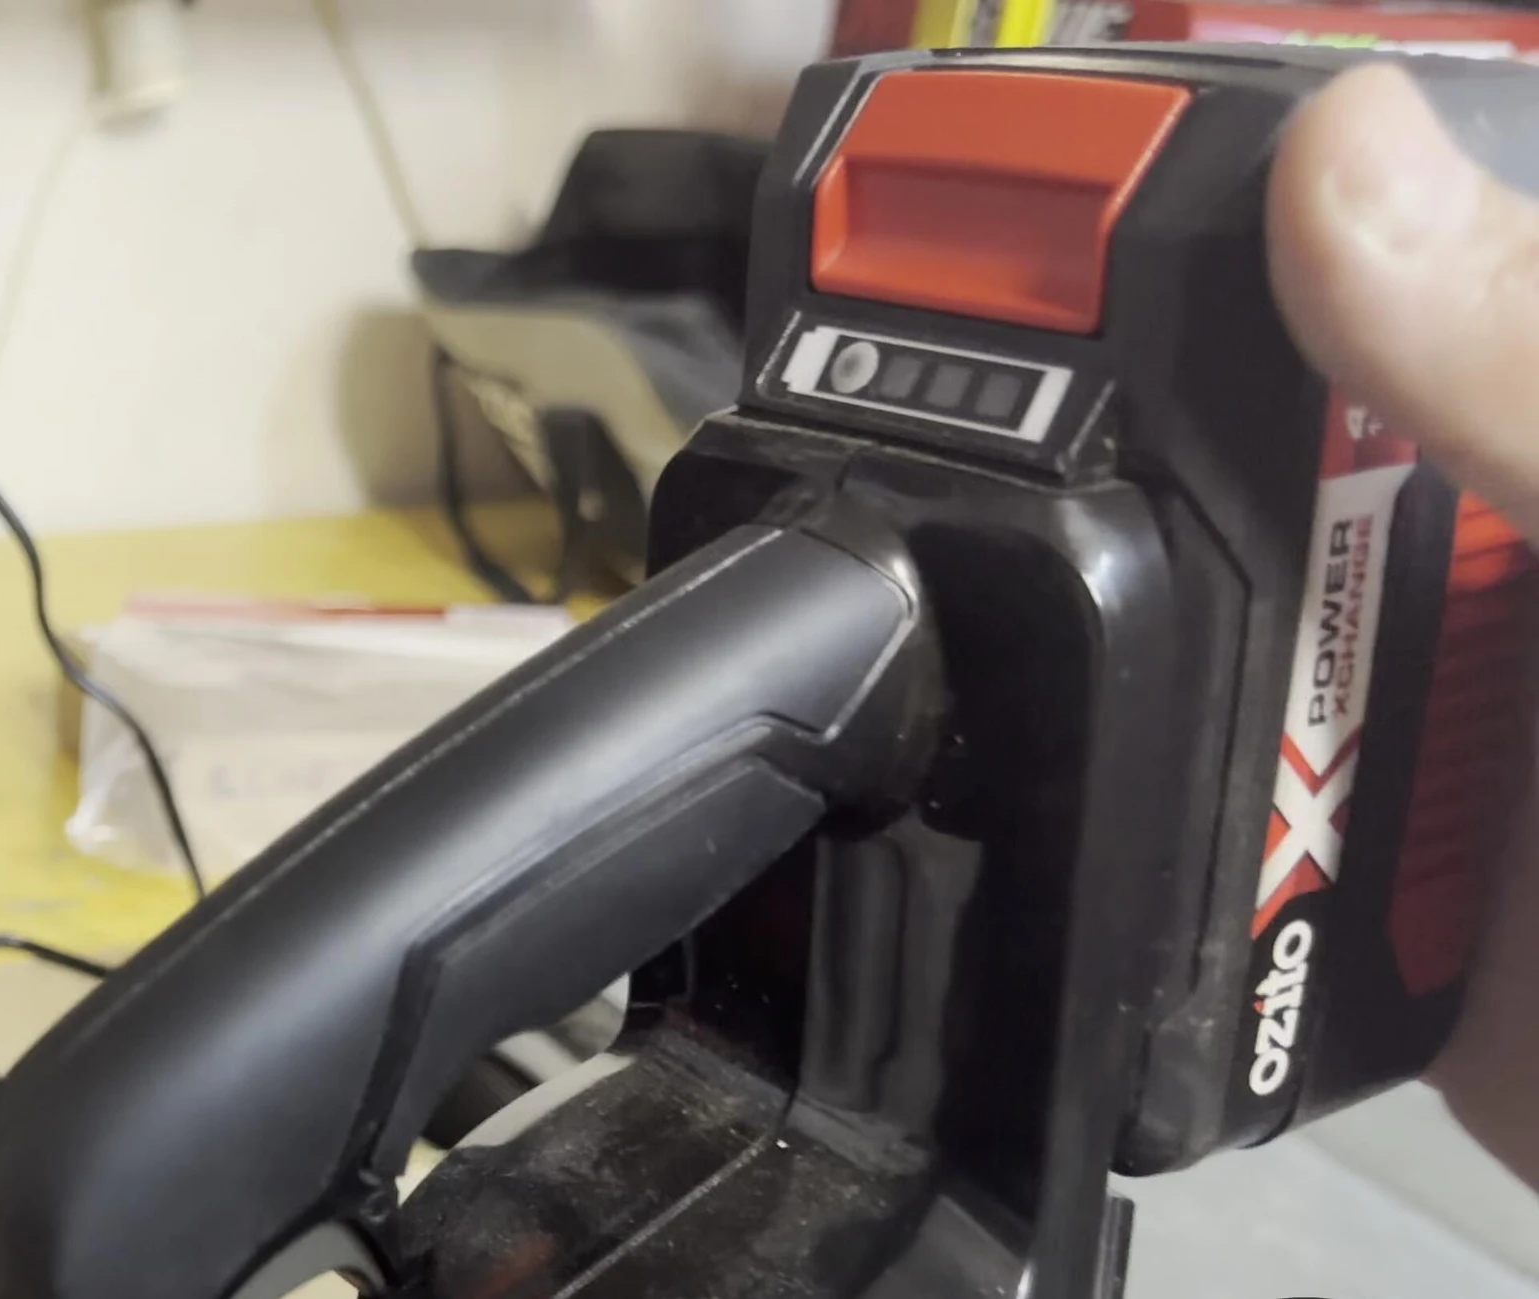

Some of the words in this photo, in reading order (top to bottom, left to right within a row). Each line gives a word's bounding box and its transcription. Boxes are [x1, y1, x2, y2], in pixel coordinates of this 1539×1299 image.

[1308, 518, 1353, 727] POWER
[1333, 514, 1374, 716] XCHANGE
[1248, 918, 1313, 1096] ozito
